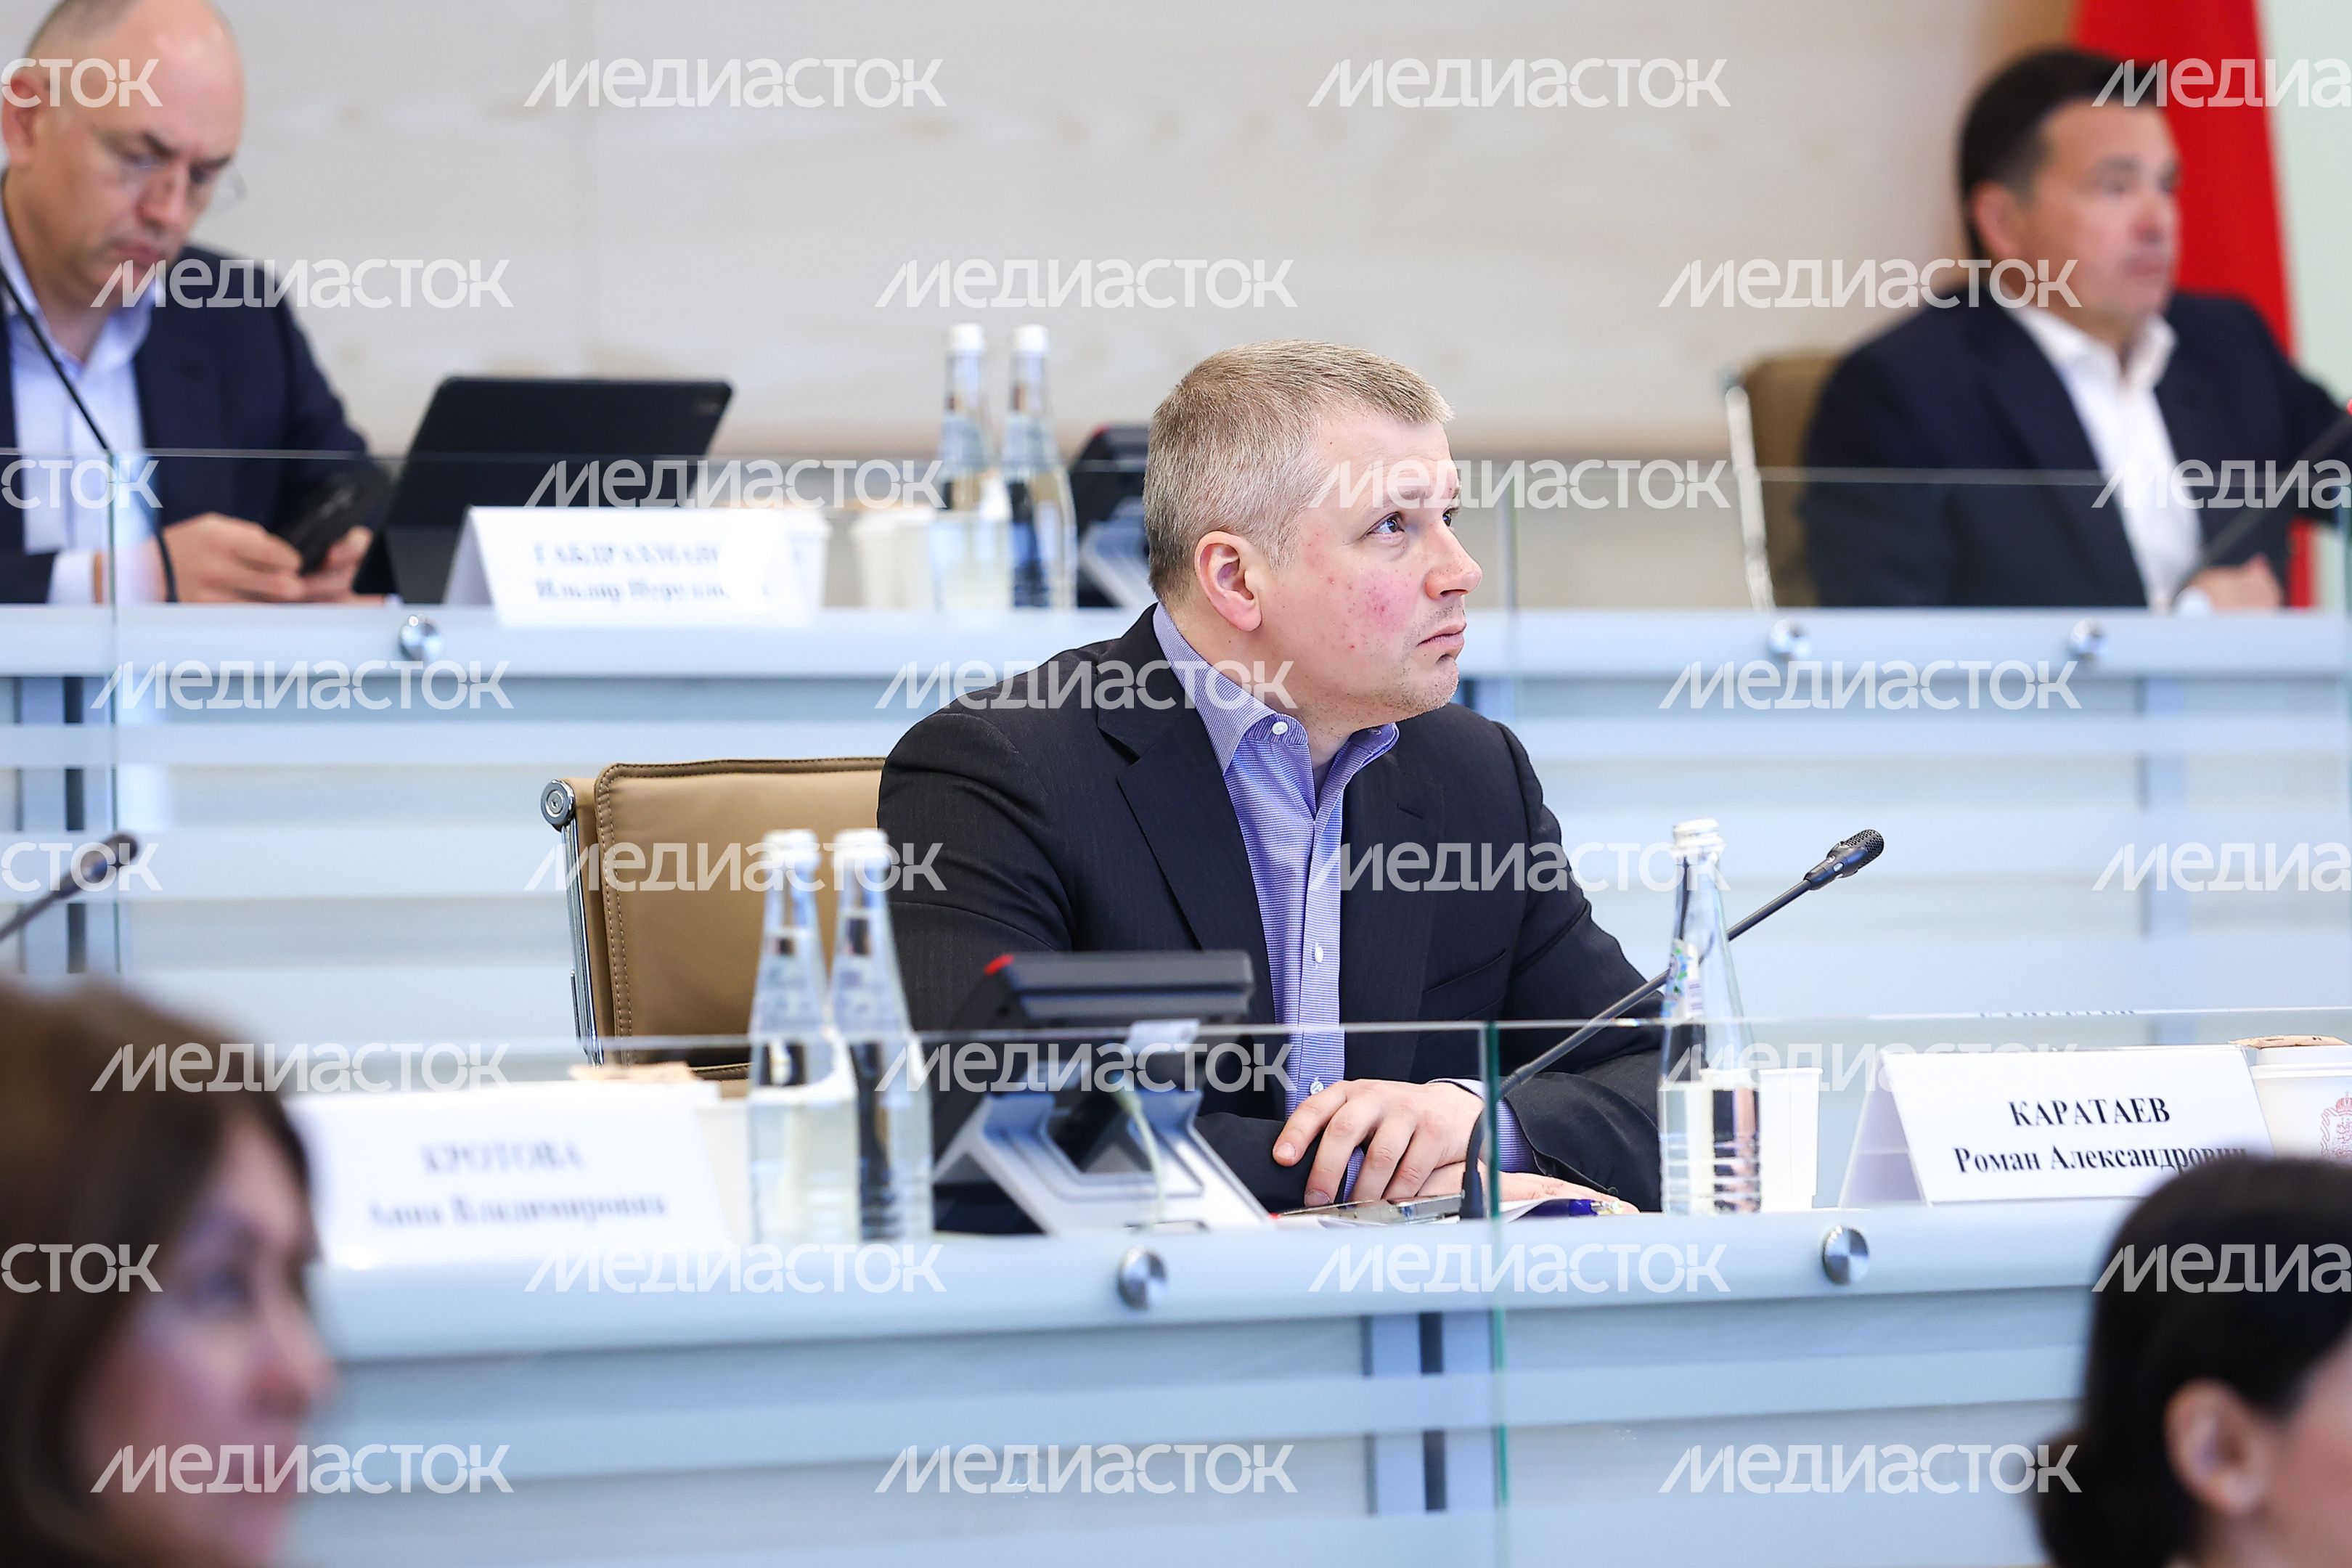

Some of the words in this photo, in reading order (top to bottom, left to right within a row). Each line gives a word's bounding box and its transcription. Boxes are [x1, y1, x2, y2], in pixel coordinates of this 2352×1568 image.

[2009, 1097, 2171, 1127] КАРАТАЕВ
[420, 1138, 587, 1177] КРОТОВА
[1953, 1146, 2042, 1174] Роман
